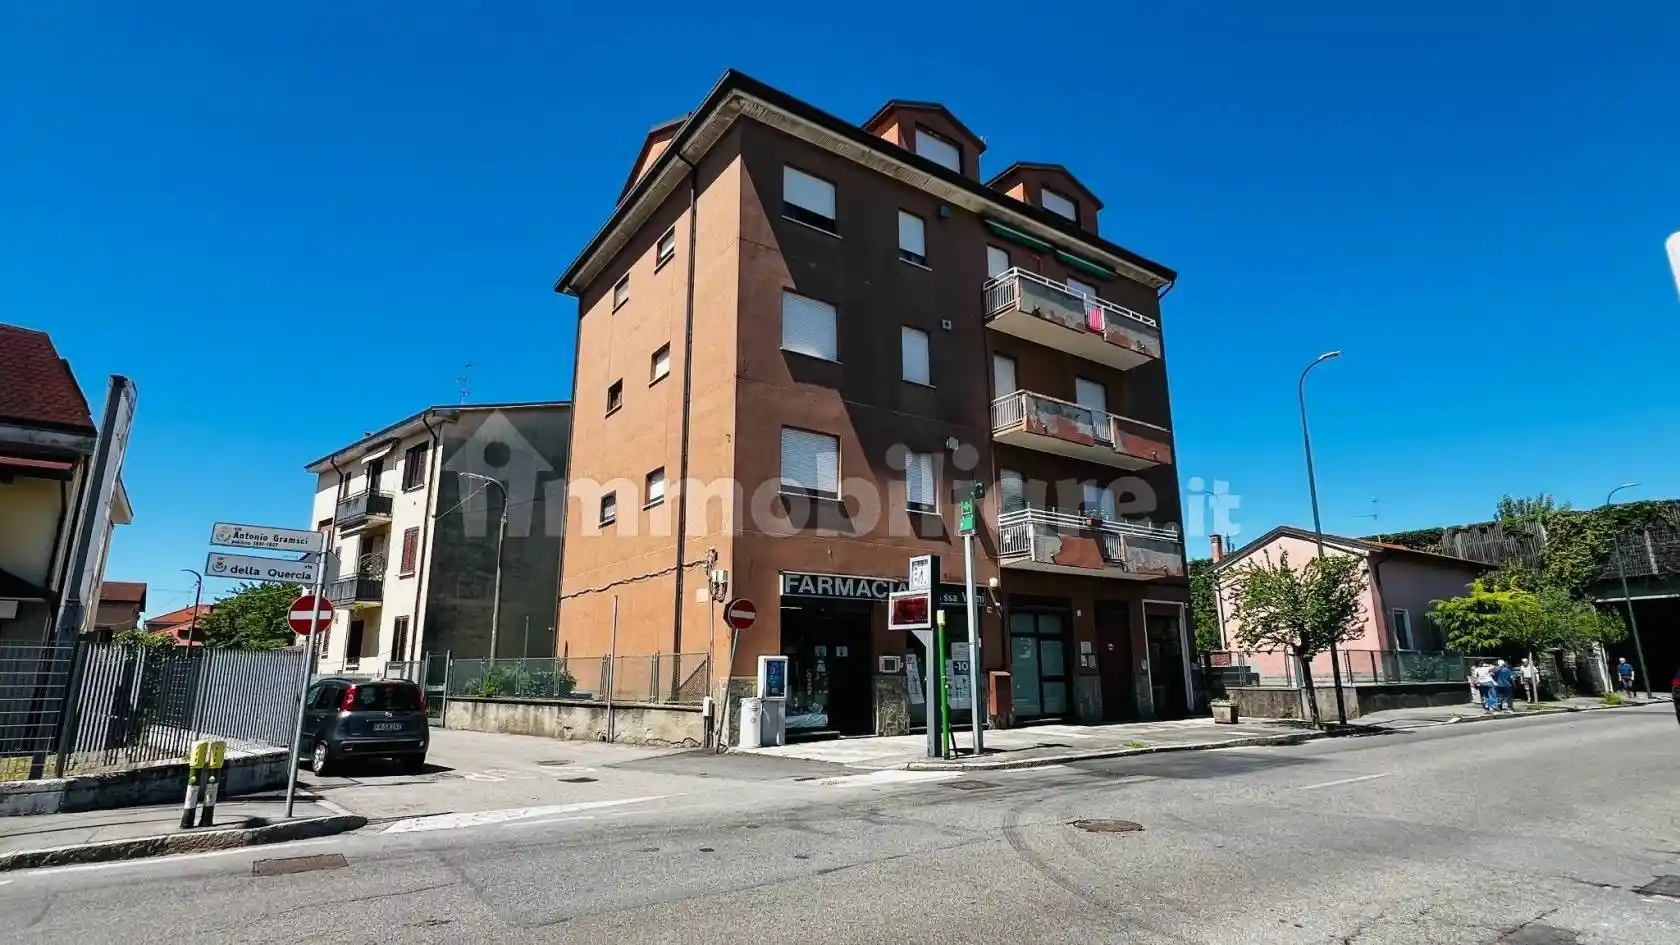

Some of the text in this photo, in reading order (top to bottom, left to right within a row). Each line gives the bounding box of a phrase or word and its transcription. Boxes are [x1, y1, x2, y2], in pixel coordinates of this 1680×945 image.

[232, 531, 309, 545] Antonio Gramsci
[230, 565, 312, 580] della Quercia
